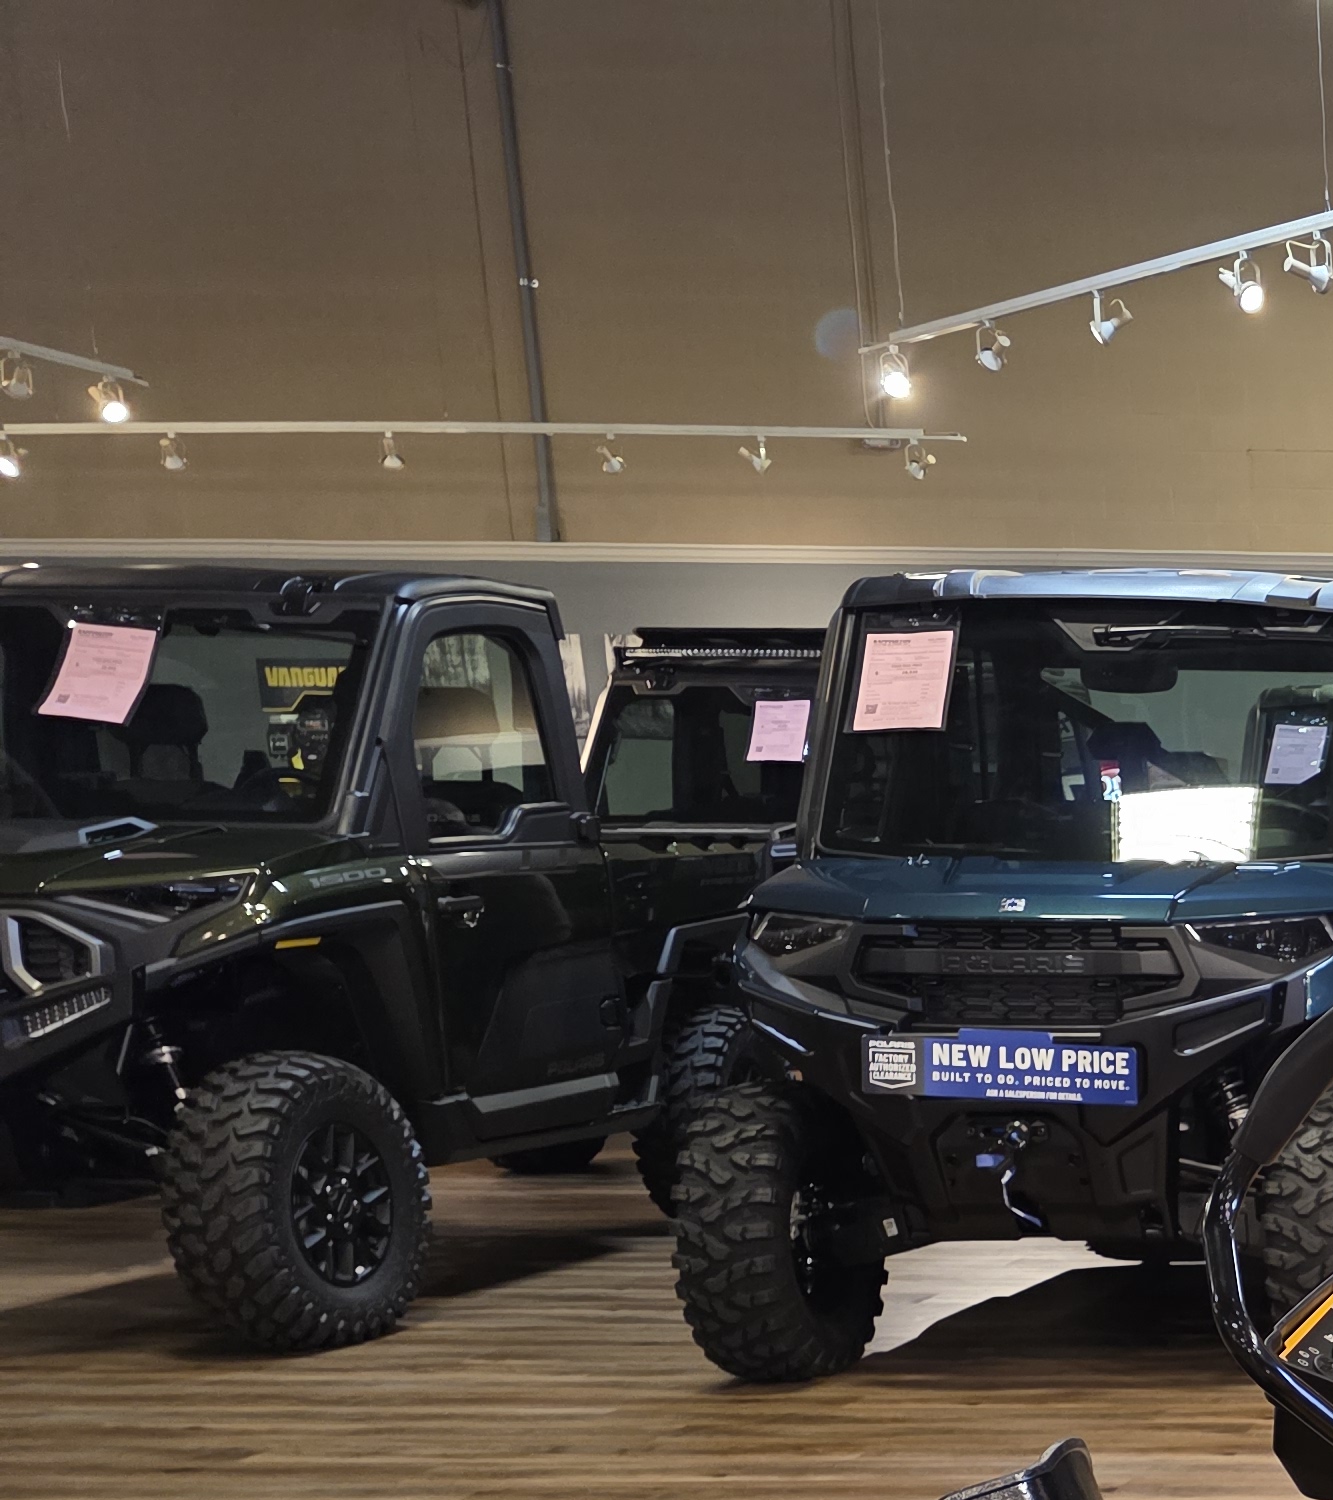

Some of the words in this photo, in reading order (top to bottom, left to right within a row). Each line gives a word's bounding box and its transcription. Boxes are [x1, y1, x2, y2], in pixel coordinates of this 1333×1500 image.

[264, 665, 346, 687] VANGUA
[942, 954, 1085, 973] POLARIS
[869, 1062, 916, 1073] AUTHORIZED
[875, 1053, 909, 1063] FACTORY
[932, 1043, 991, 1067] NEW
[999, 1046, 1054, 1071] LOW
[1062, 1050, 1130, 1075] PRICE
[932, 1071, 971, 1083] BUILT
[976, 1073, 992, 1084] TO
[1024, 1075, 1071, 1088] PRICED
[1075, 1078, 1090, 1089] TO
[1094, 1079, 1130, 1091] MOVE.
